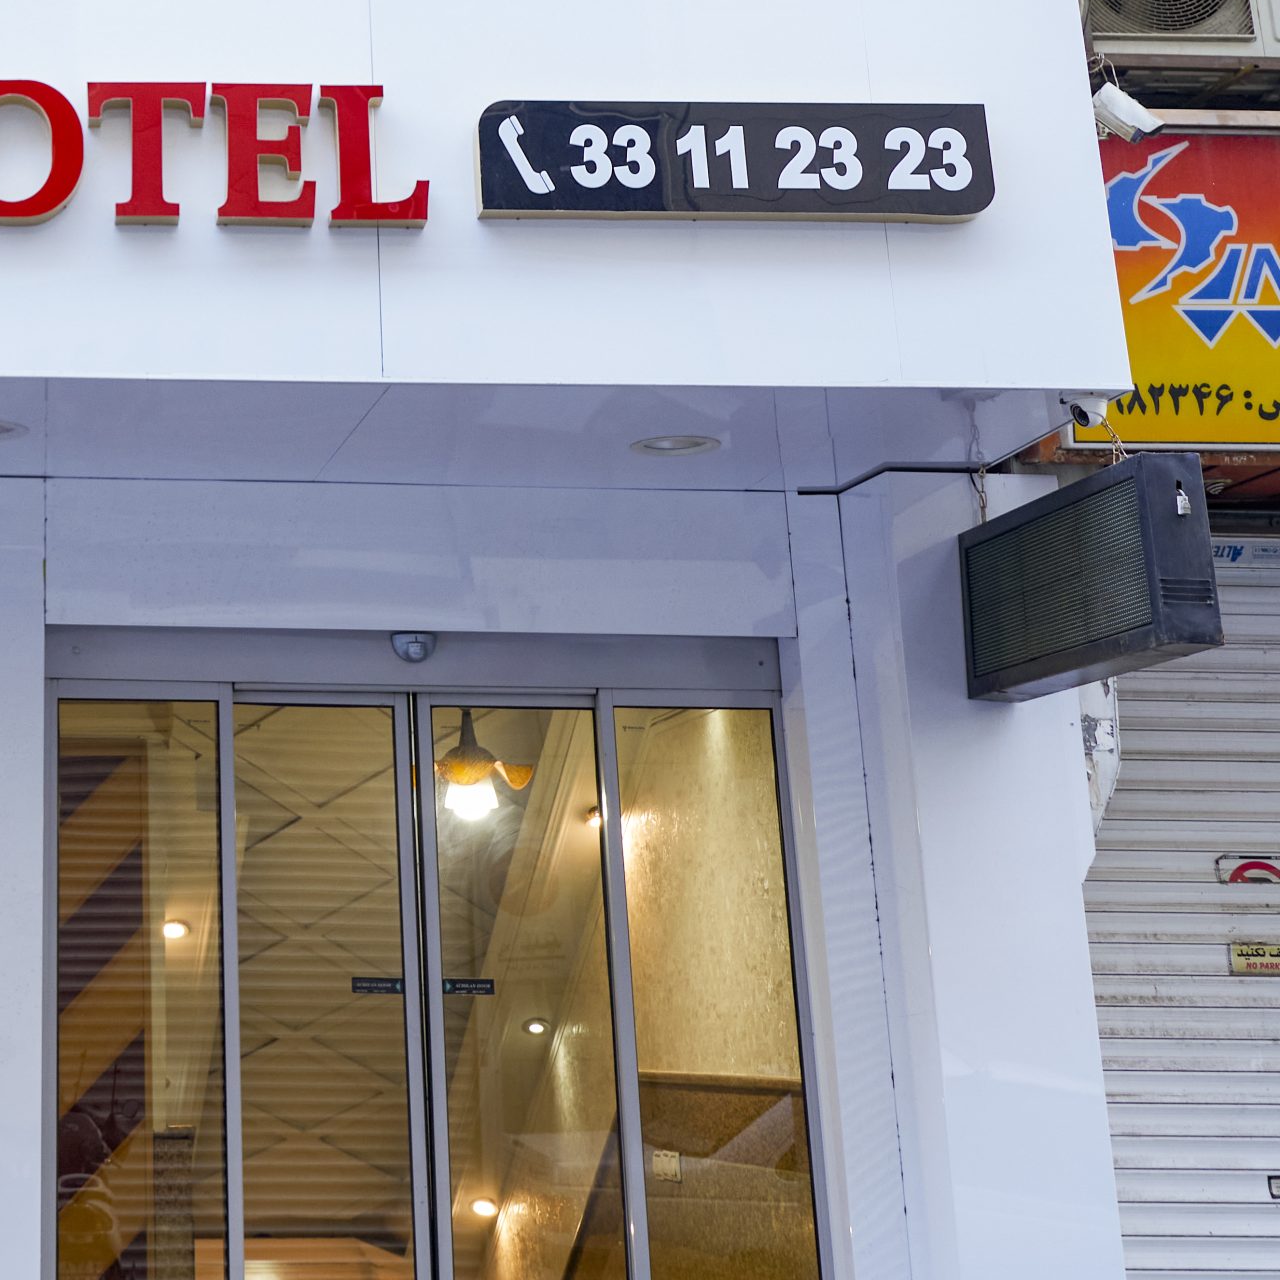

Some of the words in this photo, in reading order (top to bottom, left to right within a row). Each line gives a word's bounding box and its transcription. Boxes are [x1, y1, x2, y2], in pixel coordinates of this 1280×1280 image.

[569, 124, 656, 189] 33
[676, 125, 749, 189] 11
[775, 126, 863, 191] 23
[884, 127, 973, 191] 23
[1247, 962, 1258, 970] NO
